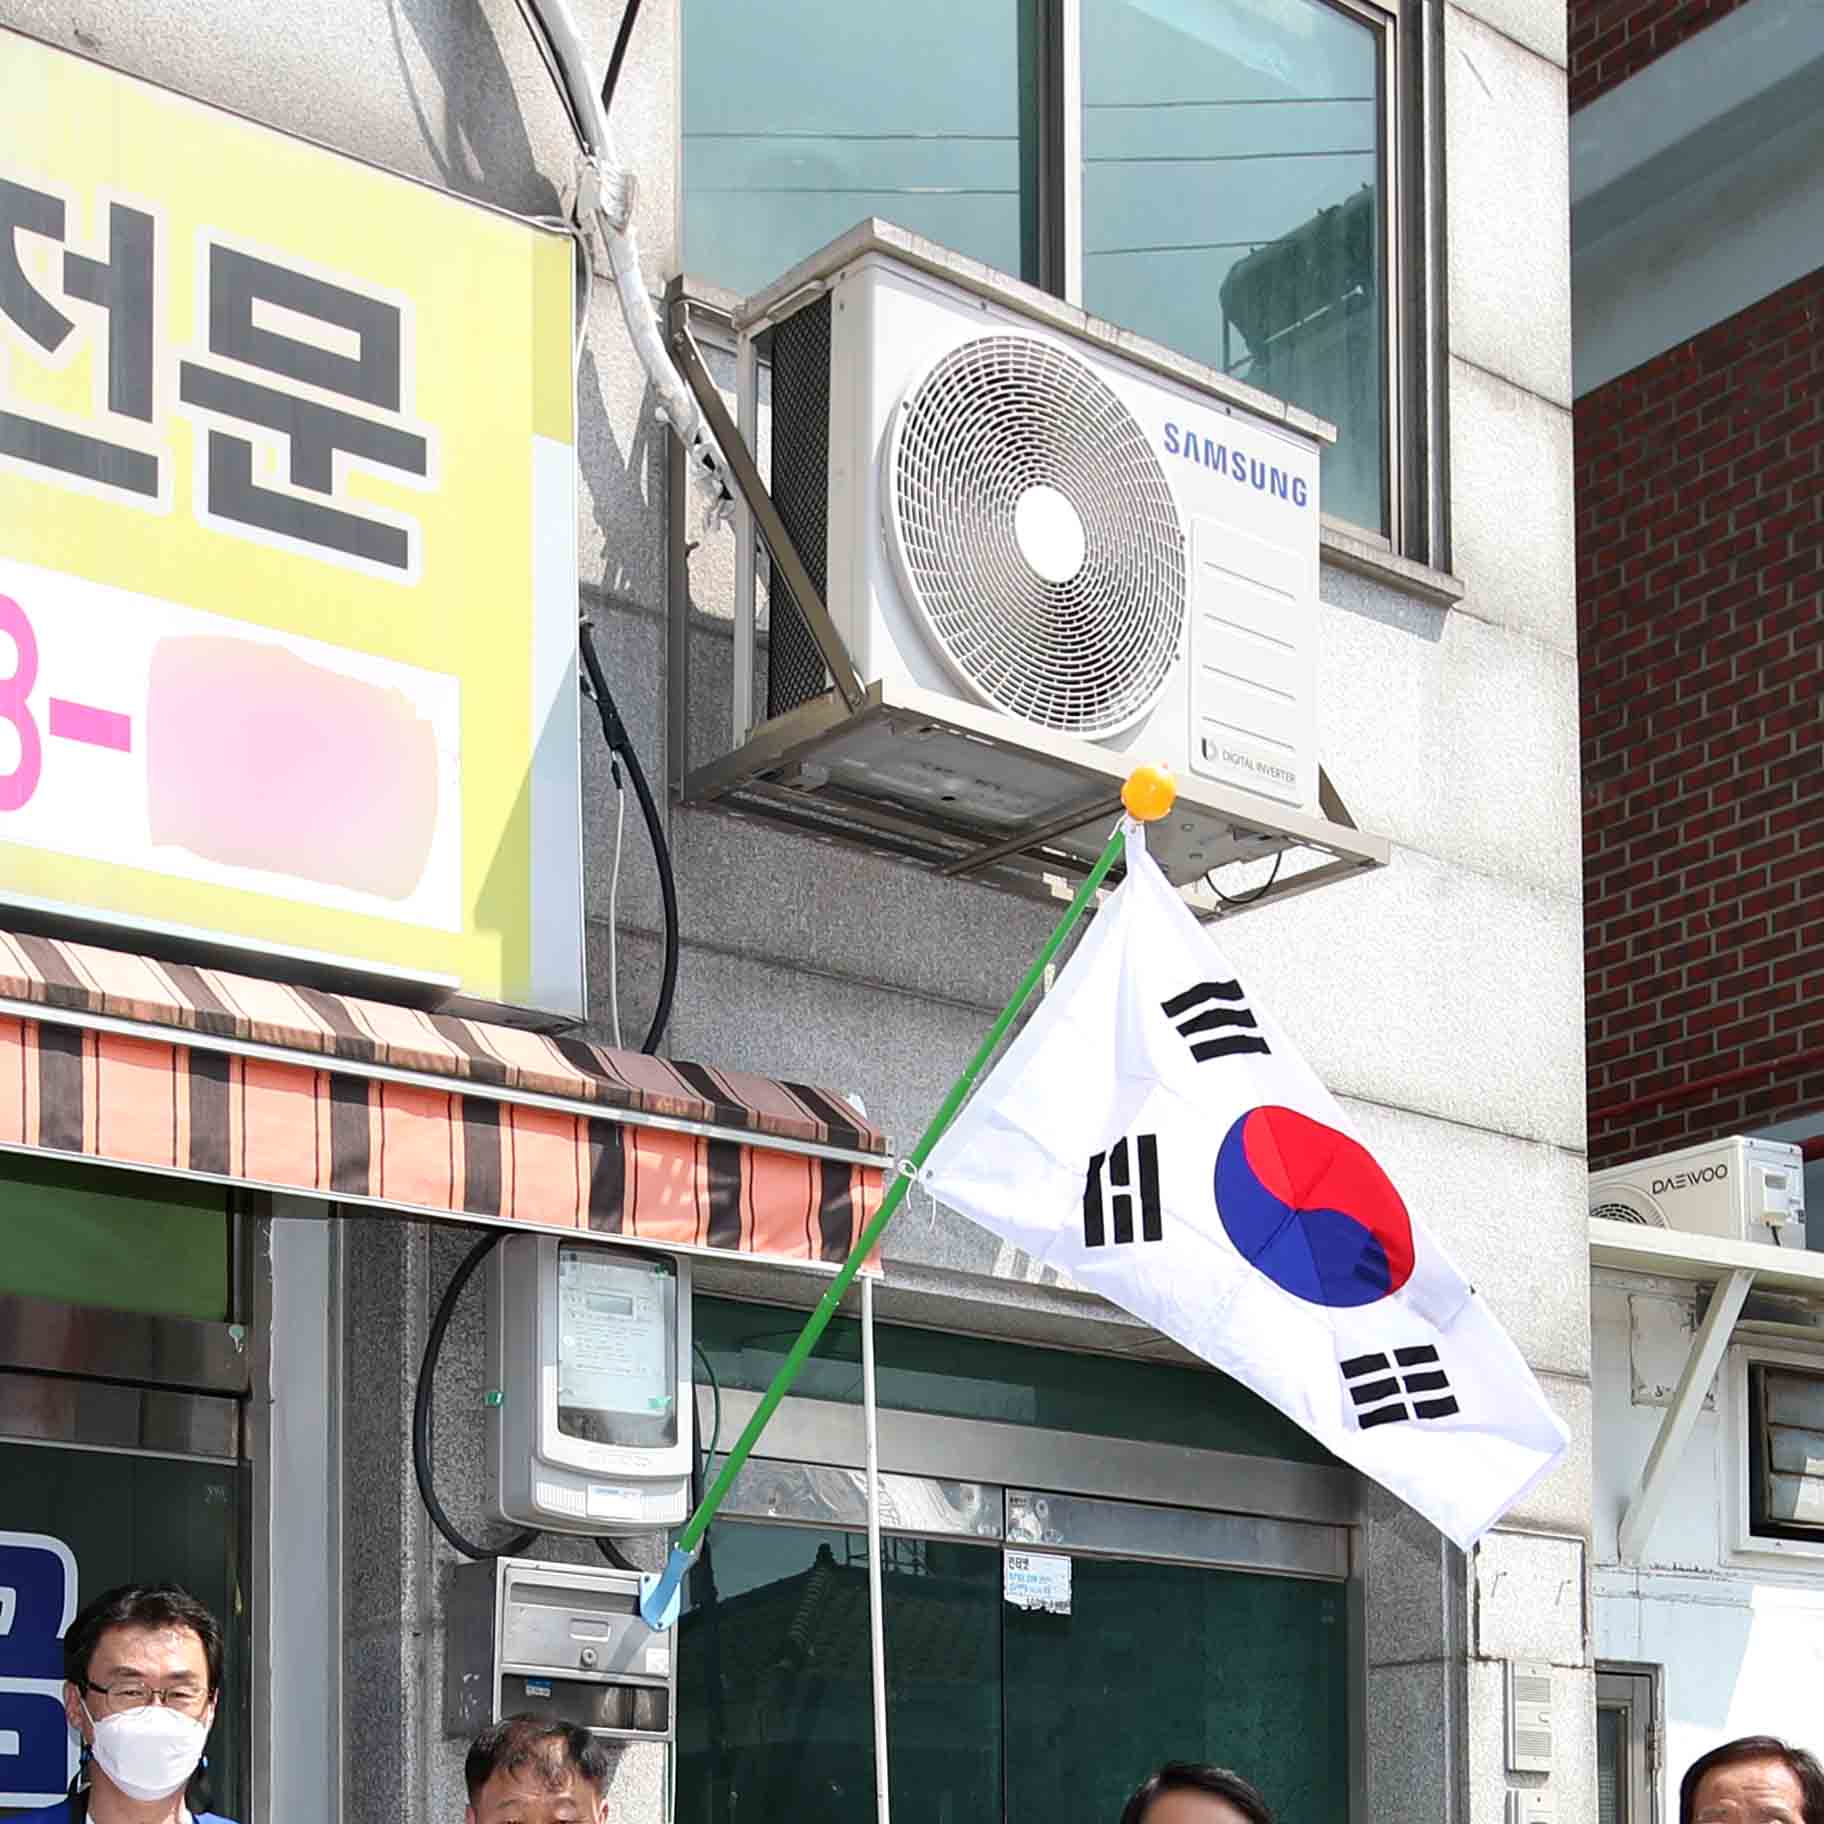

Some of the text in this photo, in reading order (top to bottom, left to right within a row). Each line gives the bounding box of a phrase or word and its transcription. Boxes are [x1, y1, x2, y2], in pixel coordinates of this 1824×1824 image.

[1163, 422, 1308, 508] SAMSUNG
[1221, 749, 1297, 784] DIGITAL INVERTER
[1651, 1164, 1728, 1195] DAEWOO
